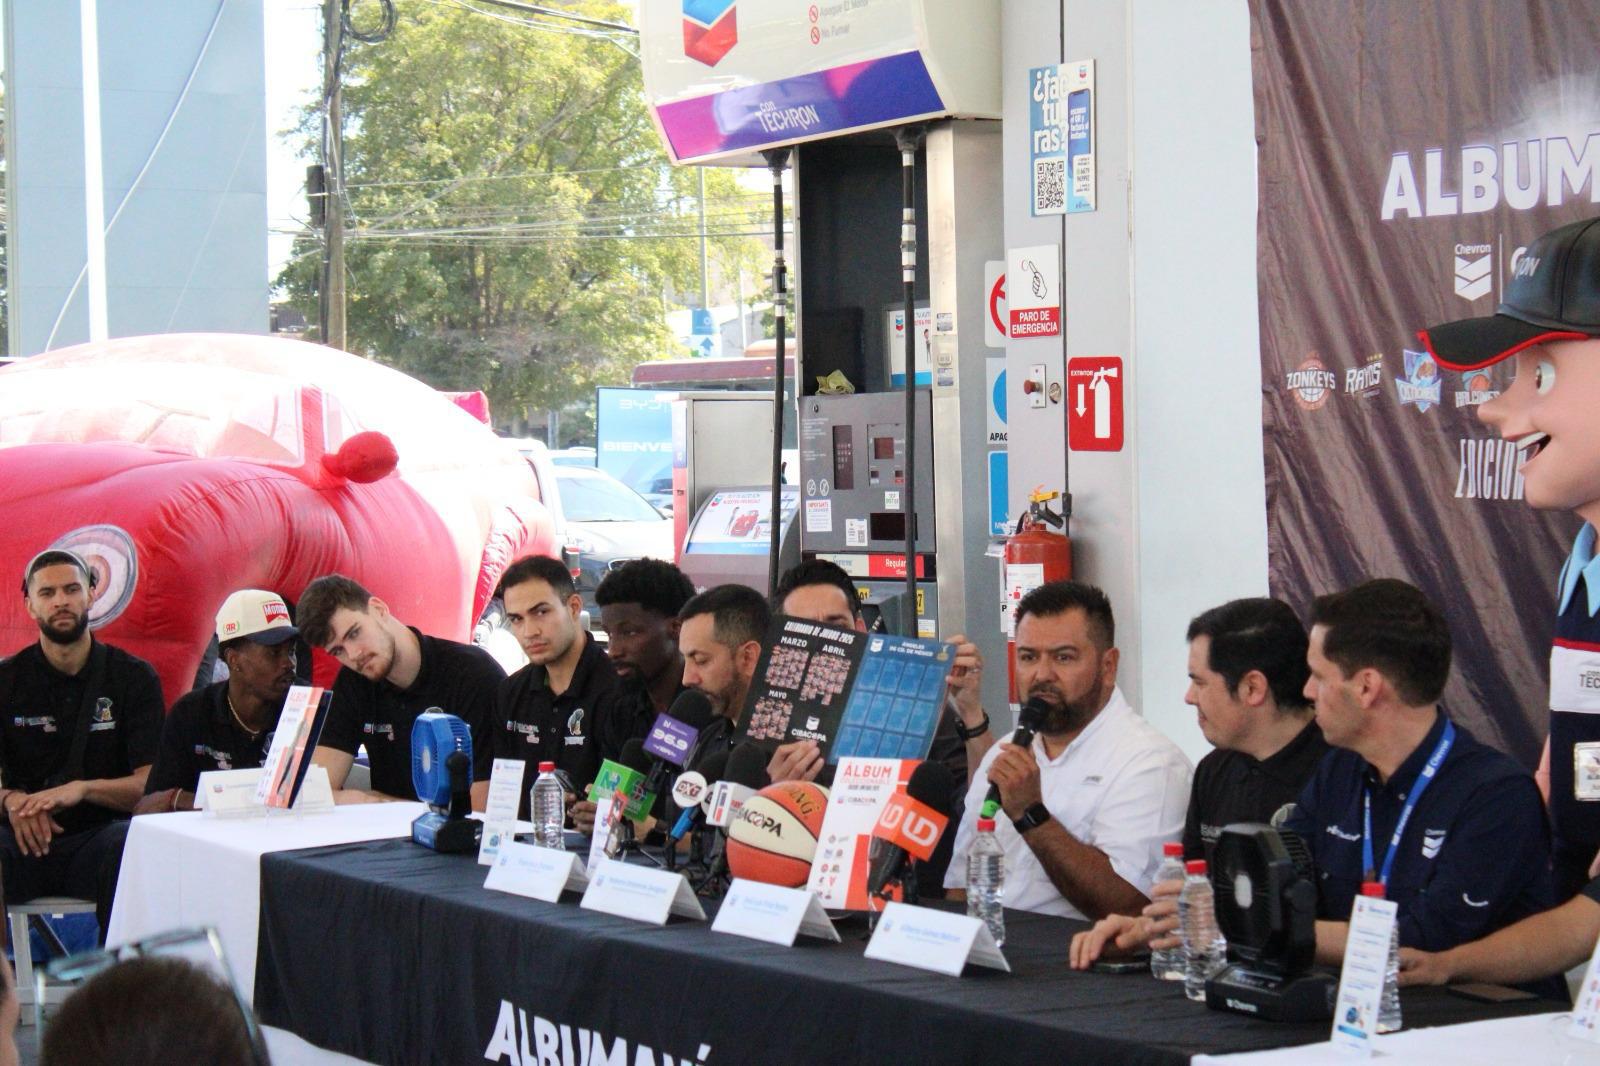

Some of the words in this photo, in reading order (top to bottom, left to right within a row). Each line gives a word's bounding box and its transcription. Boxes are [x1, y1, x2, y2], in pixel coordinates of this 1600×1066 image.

[760, 101, 777, 113] con
[755, 104, 820, 133] TECHRON
[1455, 243, 1492, 255] Chevron
[1019, 311, 1038, 323] PARO
[1039, 311, 1050, 321] DE
[1012, 321, 1058, 335] EMERGENCIA
[1286, 369, 1336, 390] ZONKEYS
[1344, 362, 1383, 393] RAYOS
[885, 558, 907, 568] Regular
[781, 636, 808, 648] MARZO
[822, 644, 846, 657] ABRIL
[768, 690, 787, 700] MAYO
